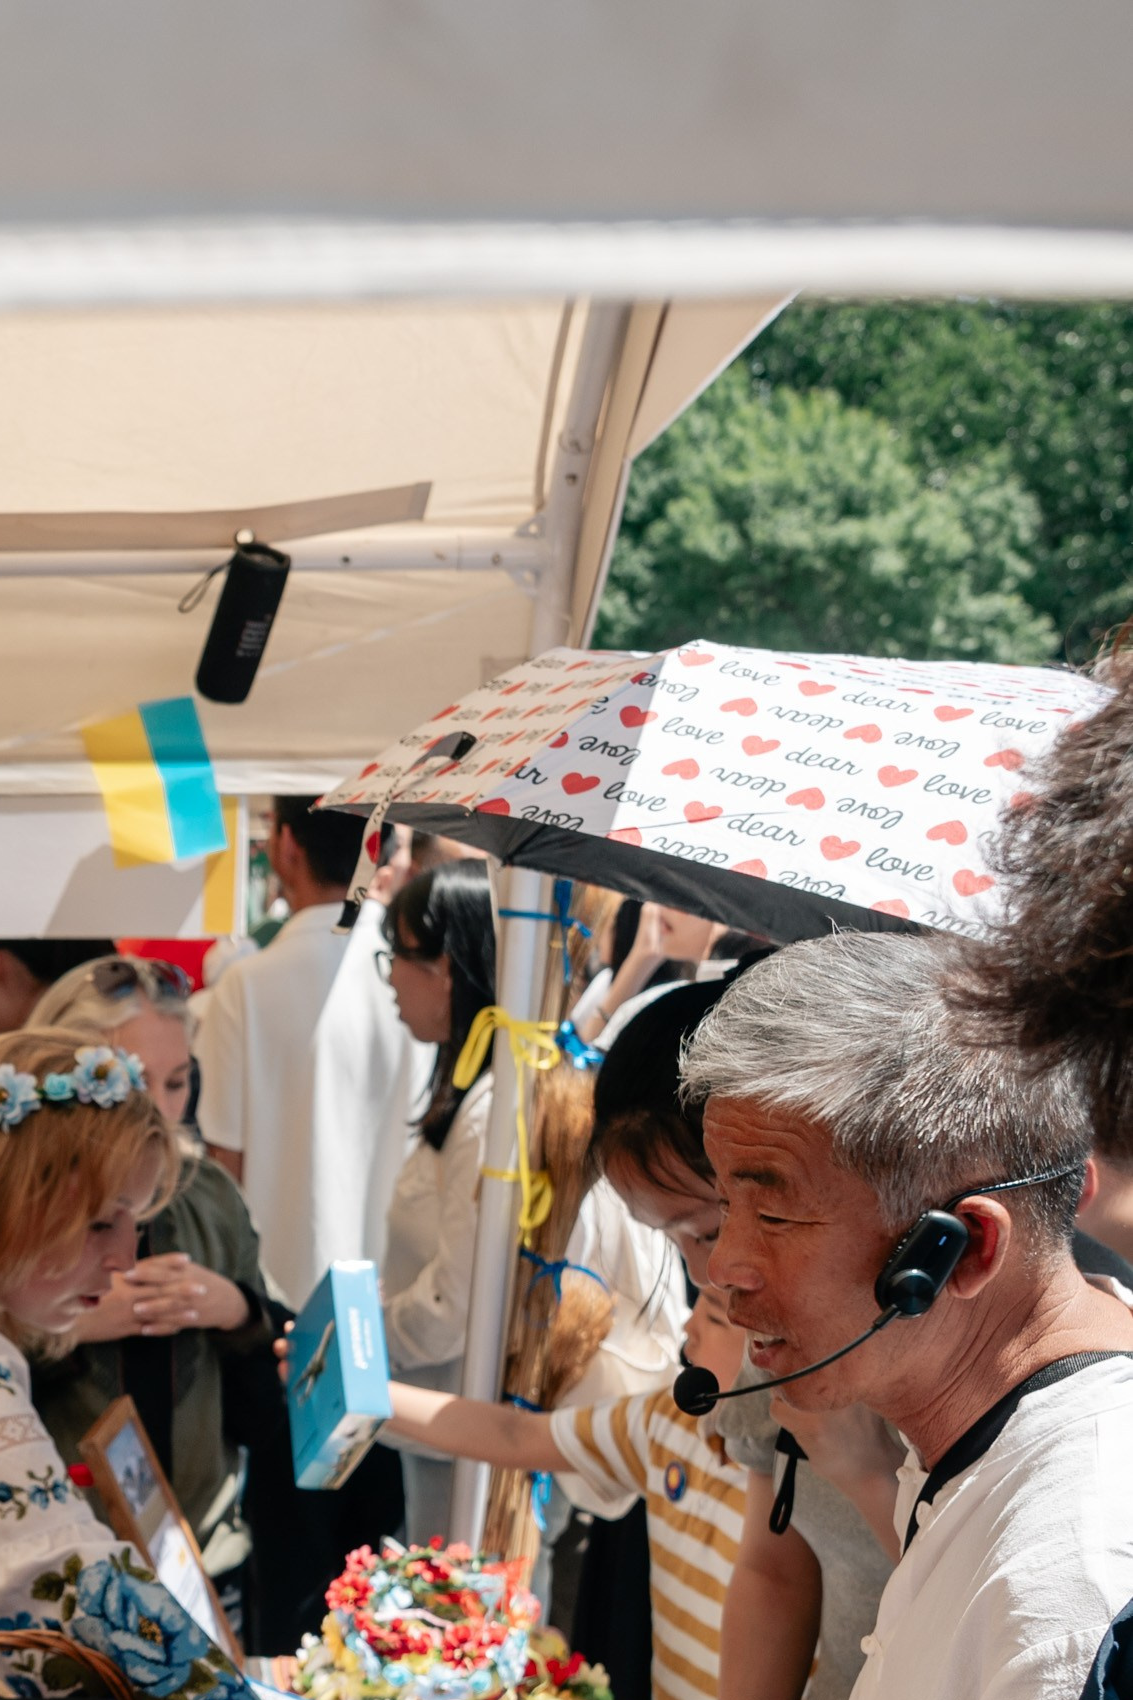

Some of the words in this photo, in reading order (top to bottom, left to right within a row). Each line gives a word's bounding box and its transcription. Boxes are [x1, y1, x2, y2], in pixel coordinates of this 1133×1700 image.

[719, 661, 782, 687] love
[842, 691, 919, 714] dear
[980, 711, 1048, 734] love
[767, 706, 844, 733] dear
[579, 735, 642, 767] love
[662, 717, 725, 745] love
[785, 747, 864, 776] dear
[923, 774, 993, 805] love
[894, 731, 961, 759] love
[709, 767, 787, 798] dear
[836, 797, 904, 829] love
[603, 782, 667, 812] love
[727, 814, 806, 847] dear
[865, 847, 935, 882] love
